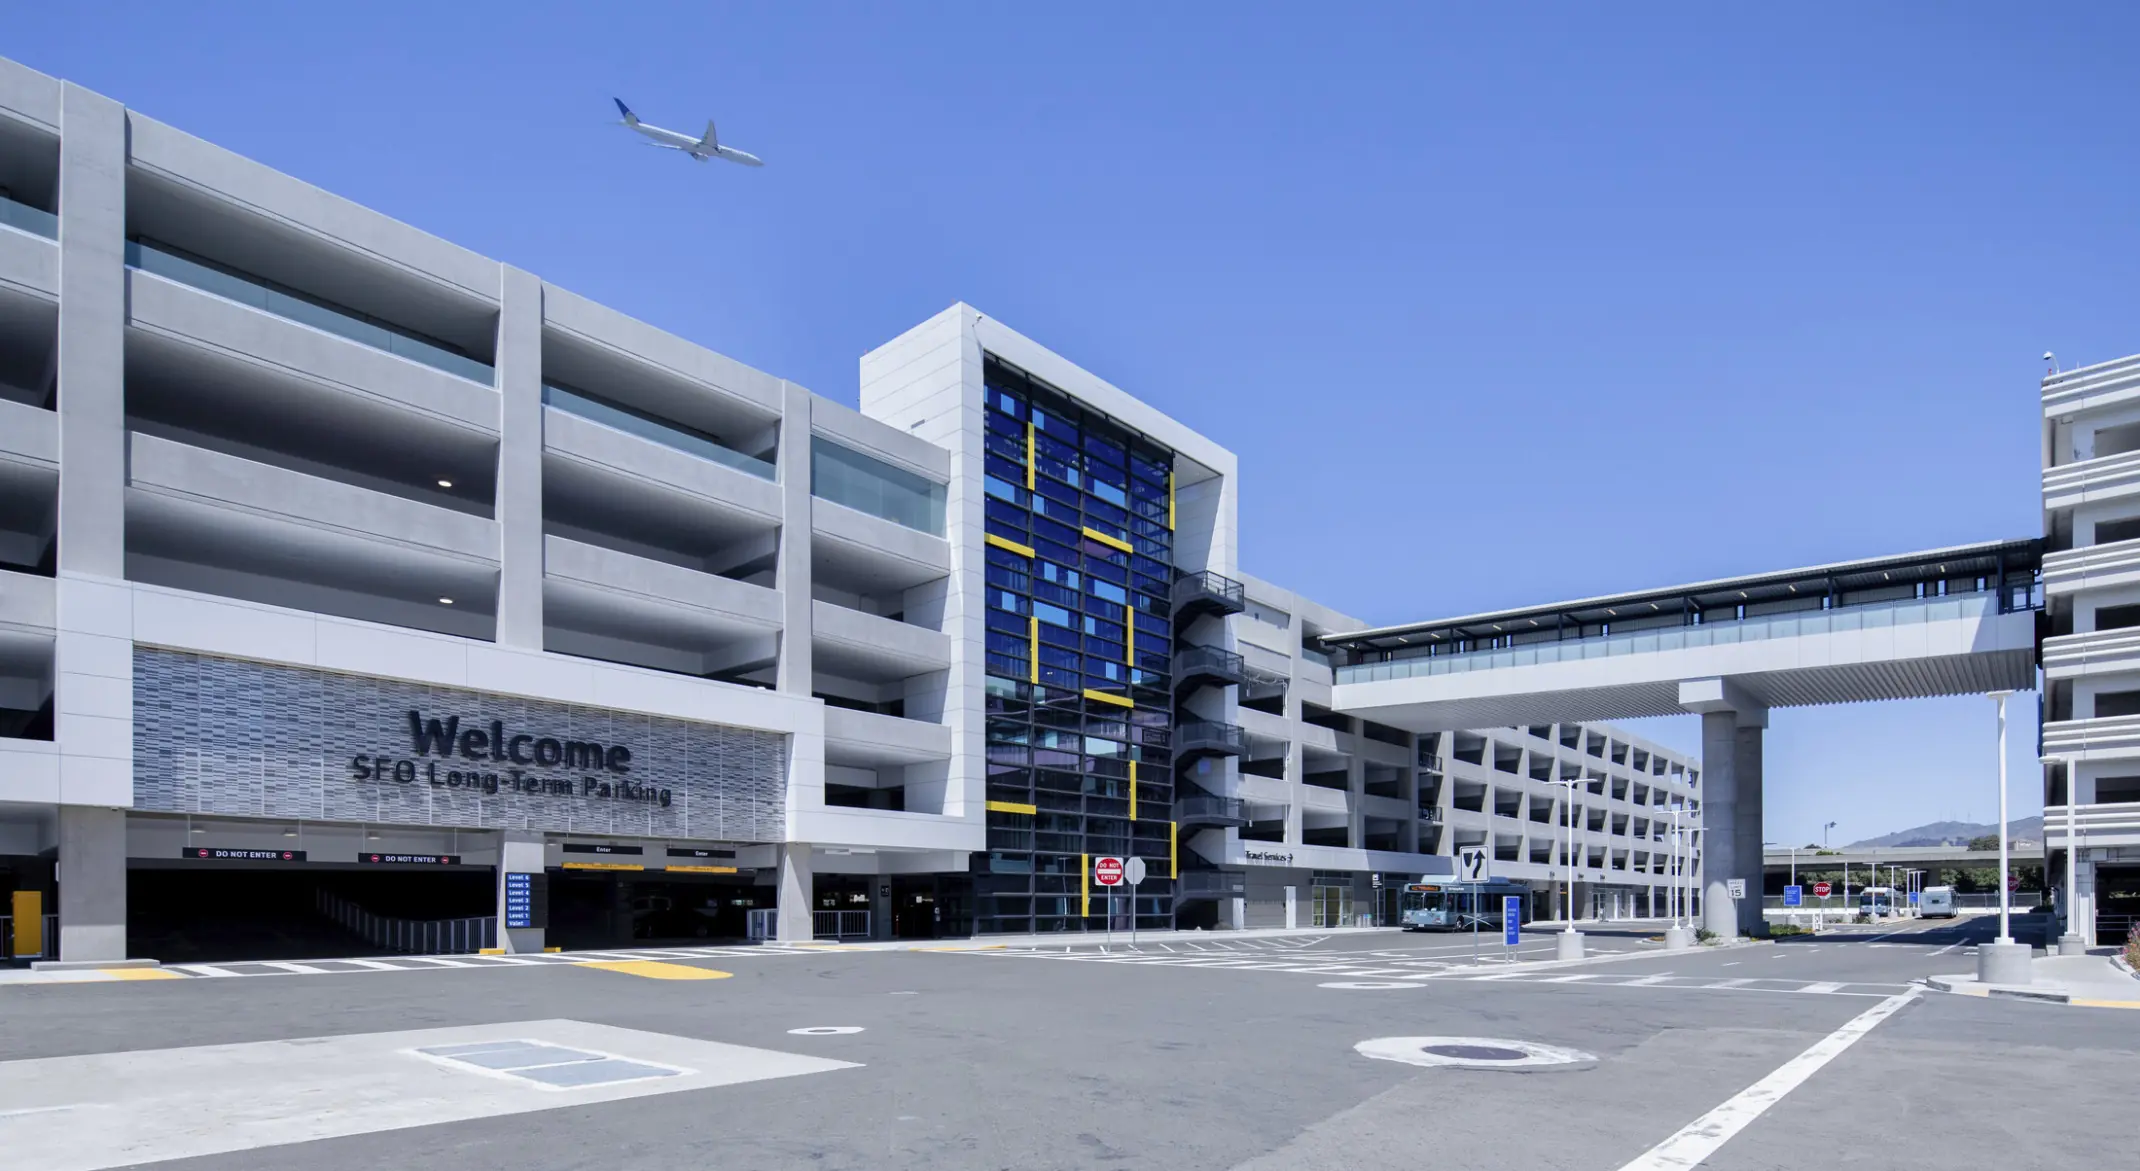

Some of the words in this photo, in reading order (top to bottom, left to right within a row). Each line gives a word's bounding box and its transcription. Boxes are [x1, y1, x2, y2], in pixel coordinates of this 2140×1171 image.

[409, 710, 631, 773] Welcome
[353, 755, 416, 784] SFO
[429, 762, 573, 795] Long-Term
[584, 775, 672, 808] Parking
[1264, 851, 1287, 861] Services
[1731, 889, 1741, 897] 15
